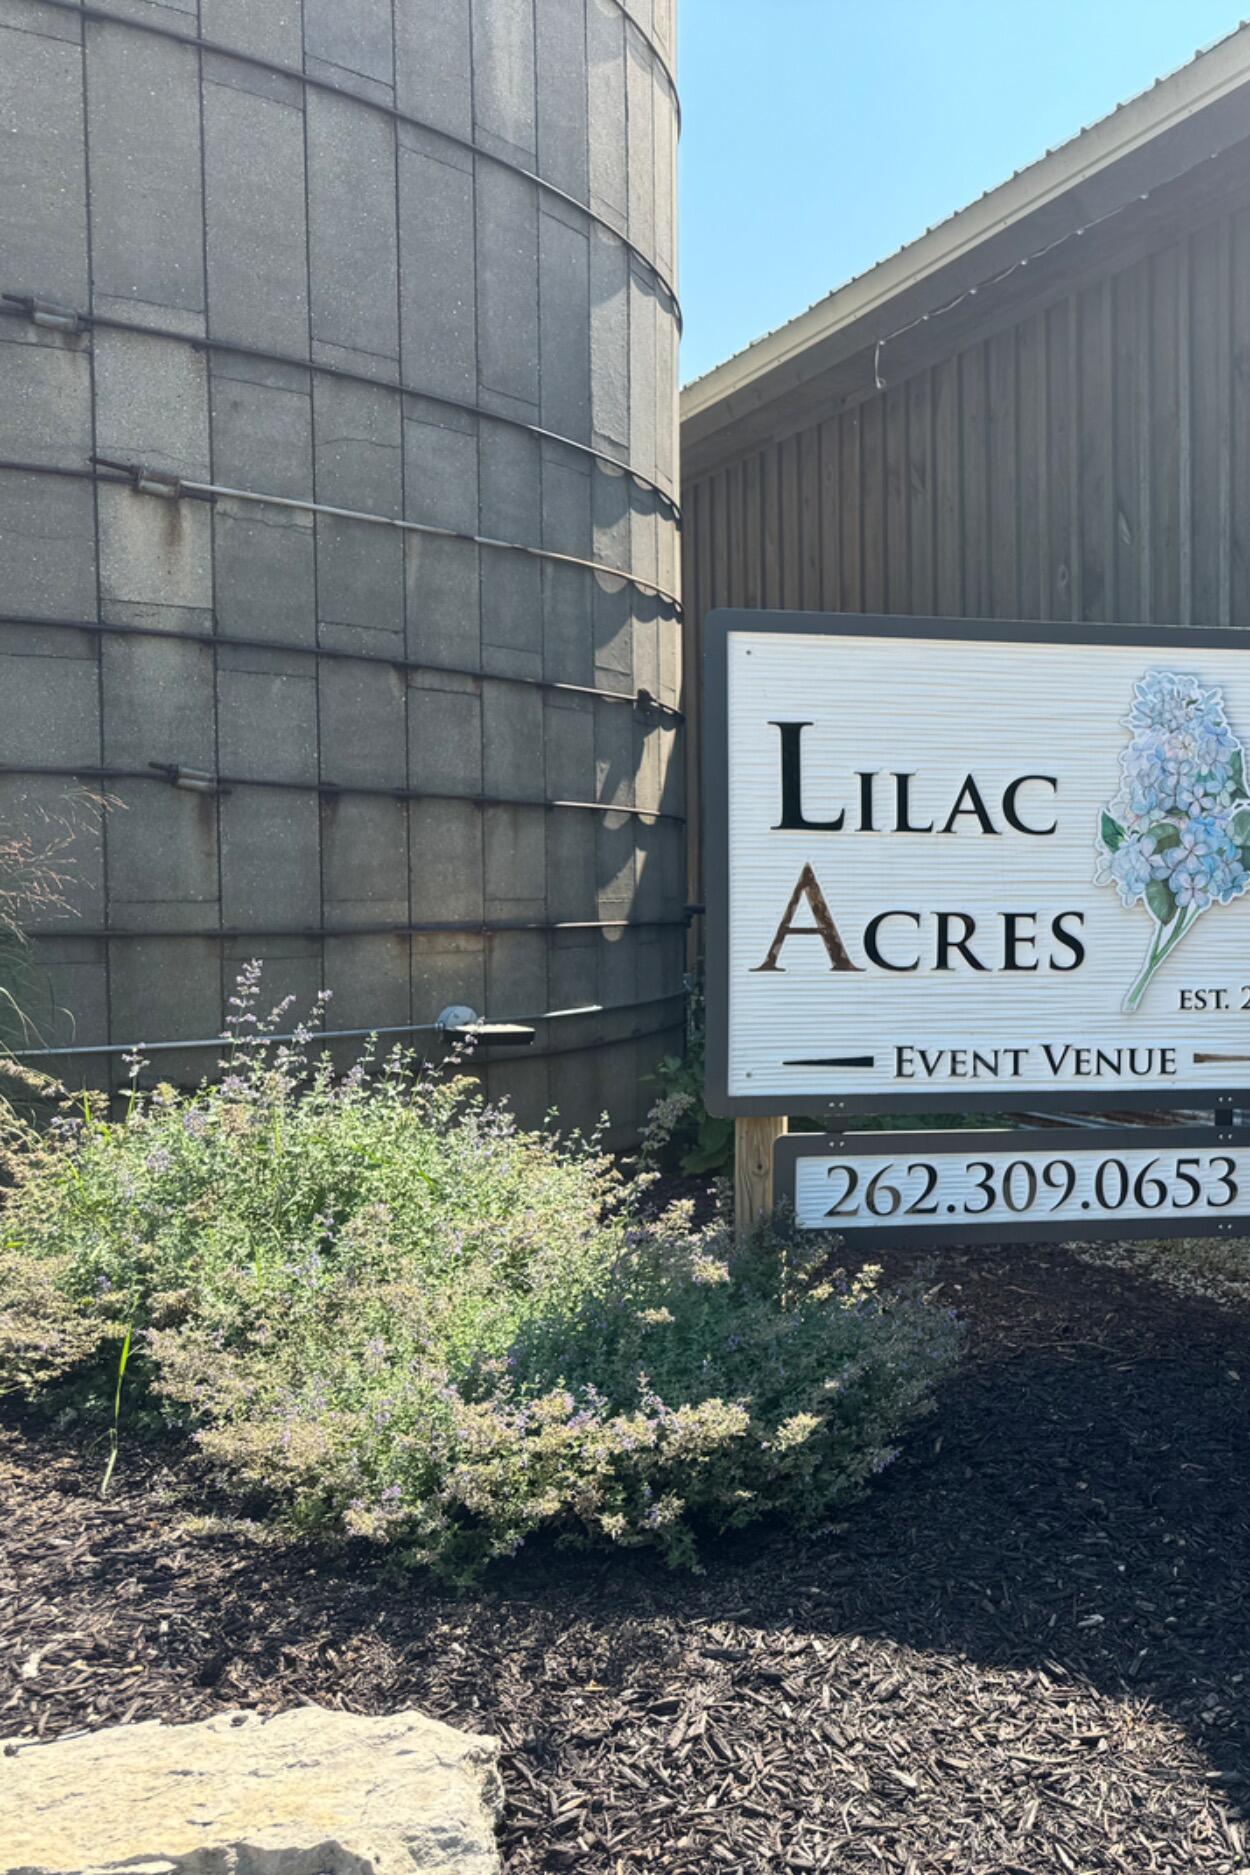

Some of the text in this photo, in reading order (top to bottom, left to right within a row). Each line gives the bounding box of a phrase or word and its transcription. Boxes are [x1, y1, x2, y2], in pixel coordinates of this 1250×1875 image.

[768, 721, 1058, 836] LILAC
[749, 863, 1086, 973] ACRES
[1179, 988, 1230, 1011] EST.
[895, 1044, 1177, 1078] EVENT VENUE
[824, 1156, 1240, 1217] 262.309.0653
